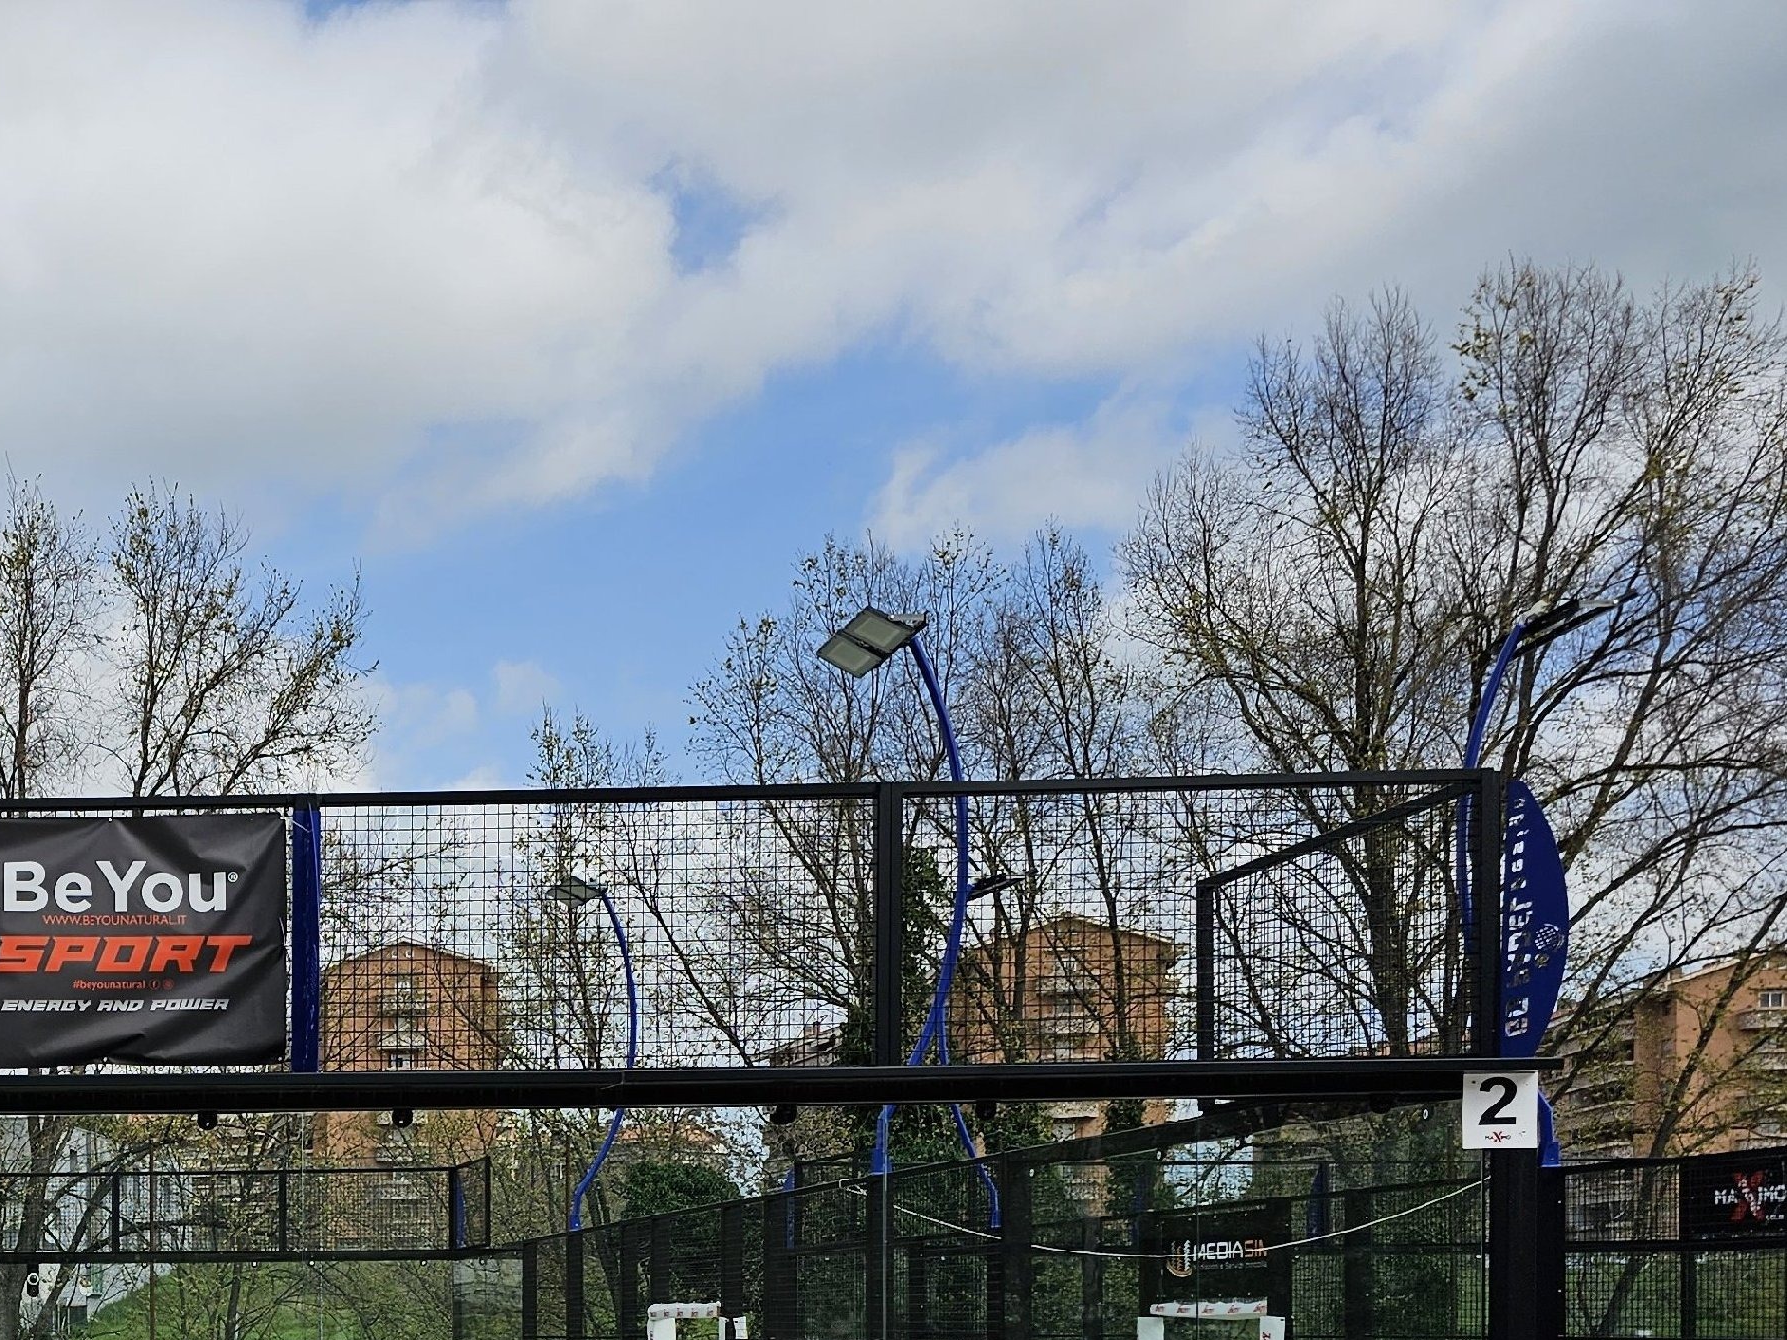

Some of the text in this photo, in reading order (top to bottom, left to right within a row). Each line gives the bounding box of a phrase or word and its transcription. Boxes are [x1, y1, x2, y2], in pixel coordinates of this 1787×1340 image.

[1, 998, 230, 1012] ENERGY AND POWER
[1479, 1077, 1517, 1125] 2
